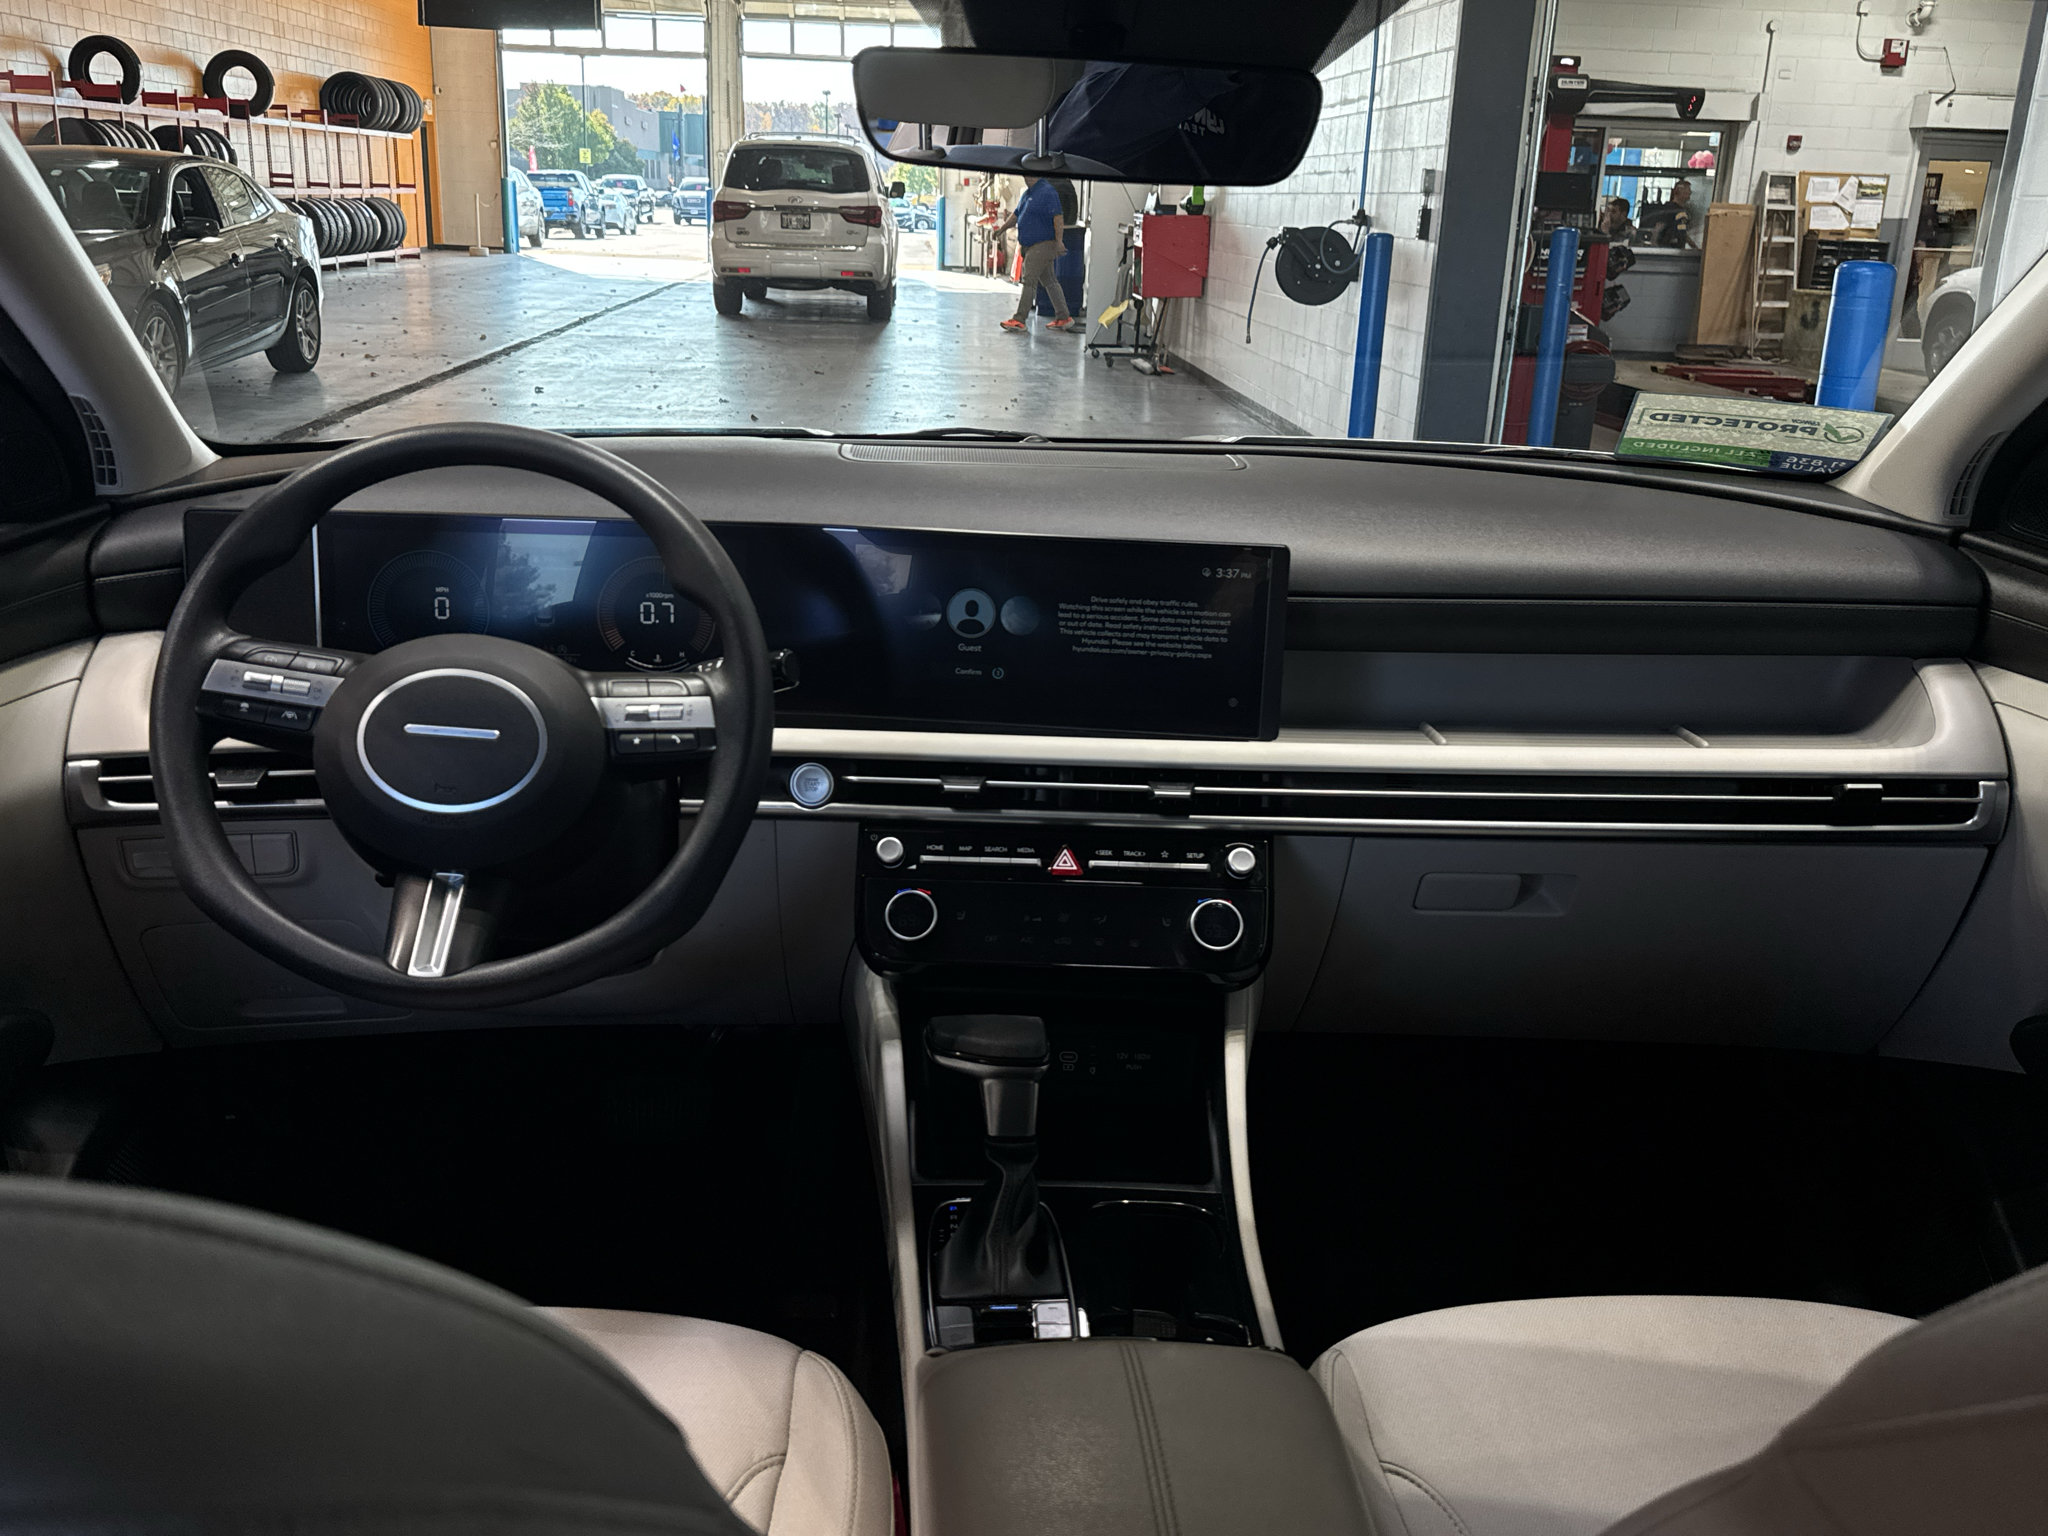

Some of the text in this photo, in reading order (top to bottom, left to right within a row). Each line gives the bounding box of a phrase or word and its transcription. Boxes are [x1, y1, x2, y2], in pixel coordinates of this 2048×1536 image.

[1216, 568, 1240, 579] 3:37
[434, 596, 450, 620] 0
[1058, 603, 1090, 612] Watching
[640, 602, 674, 624] 0.7
[958, 643, 982, 652] Guest
[954, 667, 983, 676] Confirm
